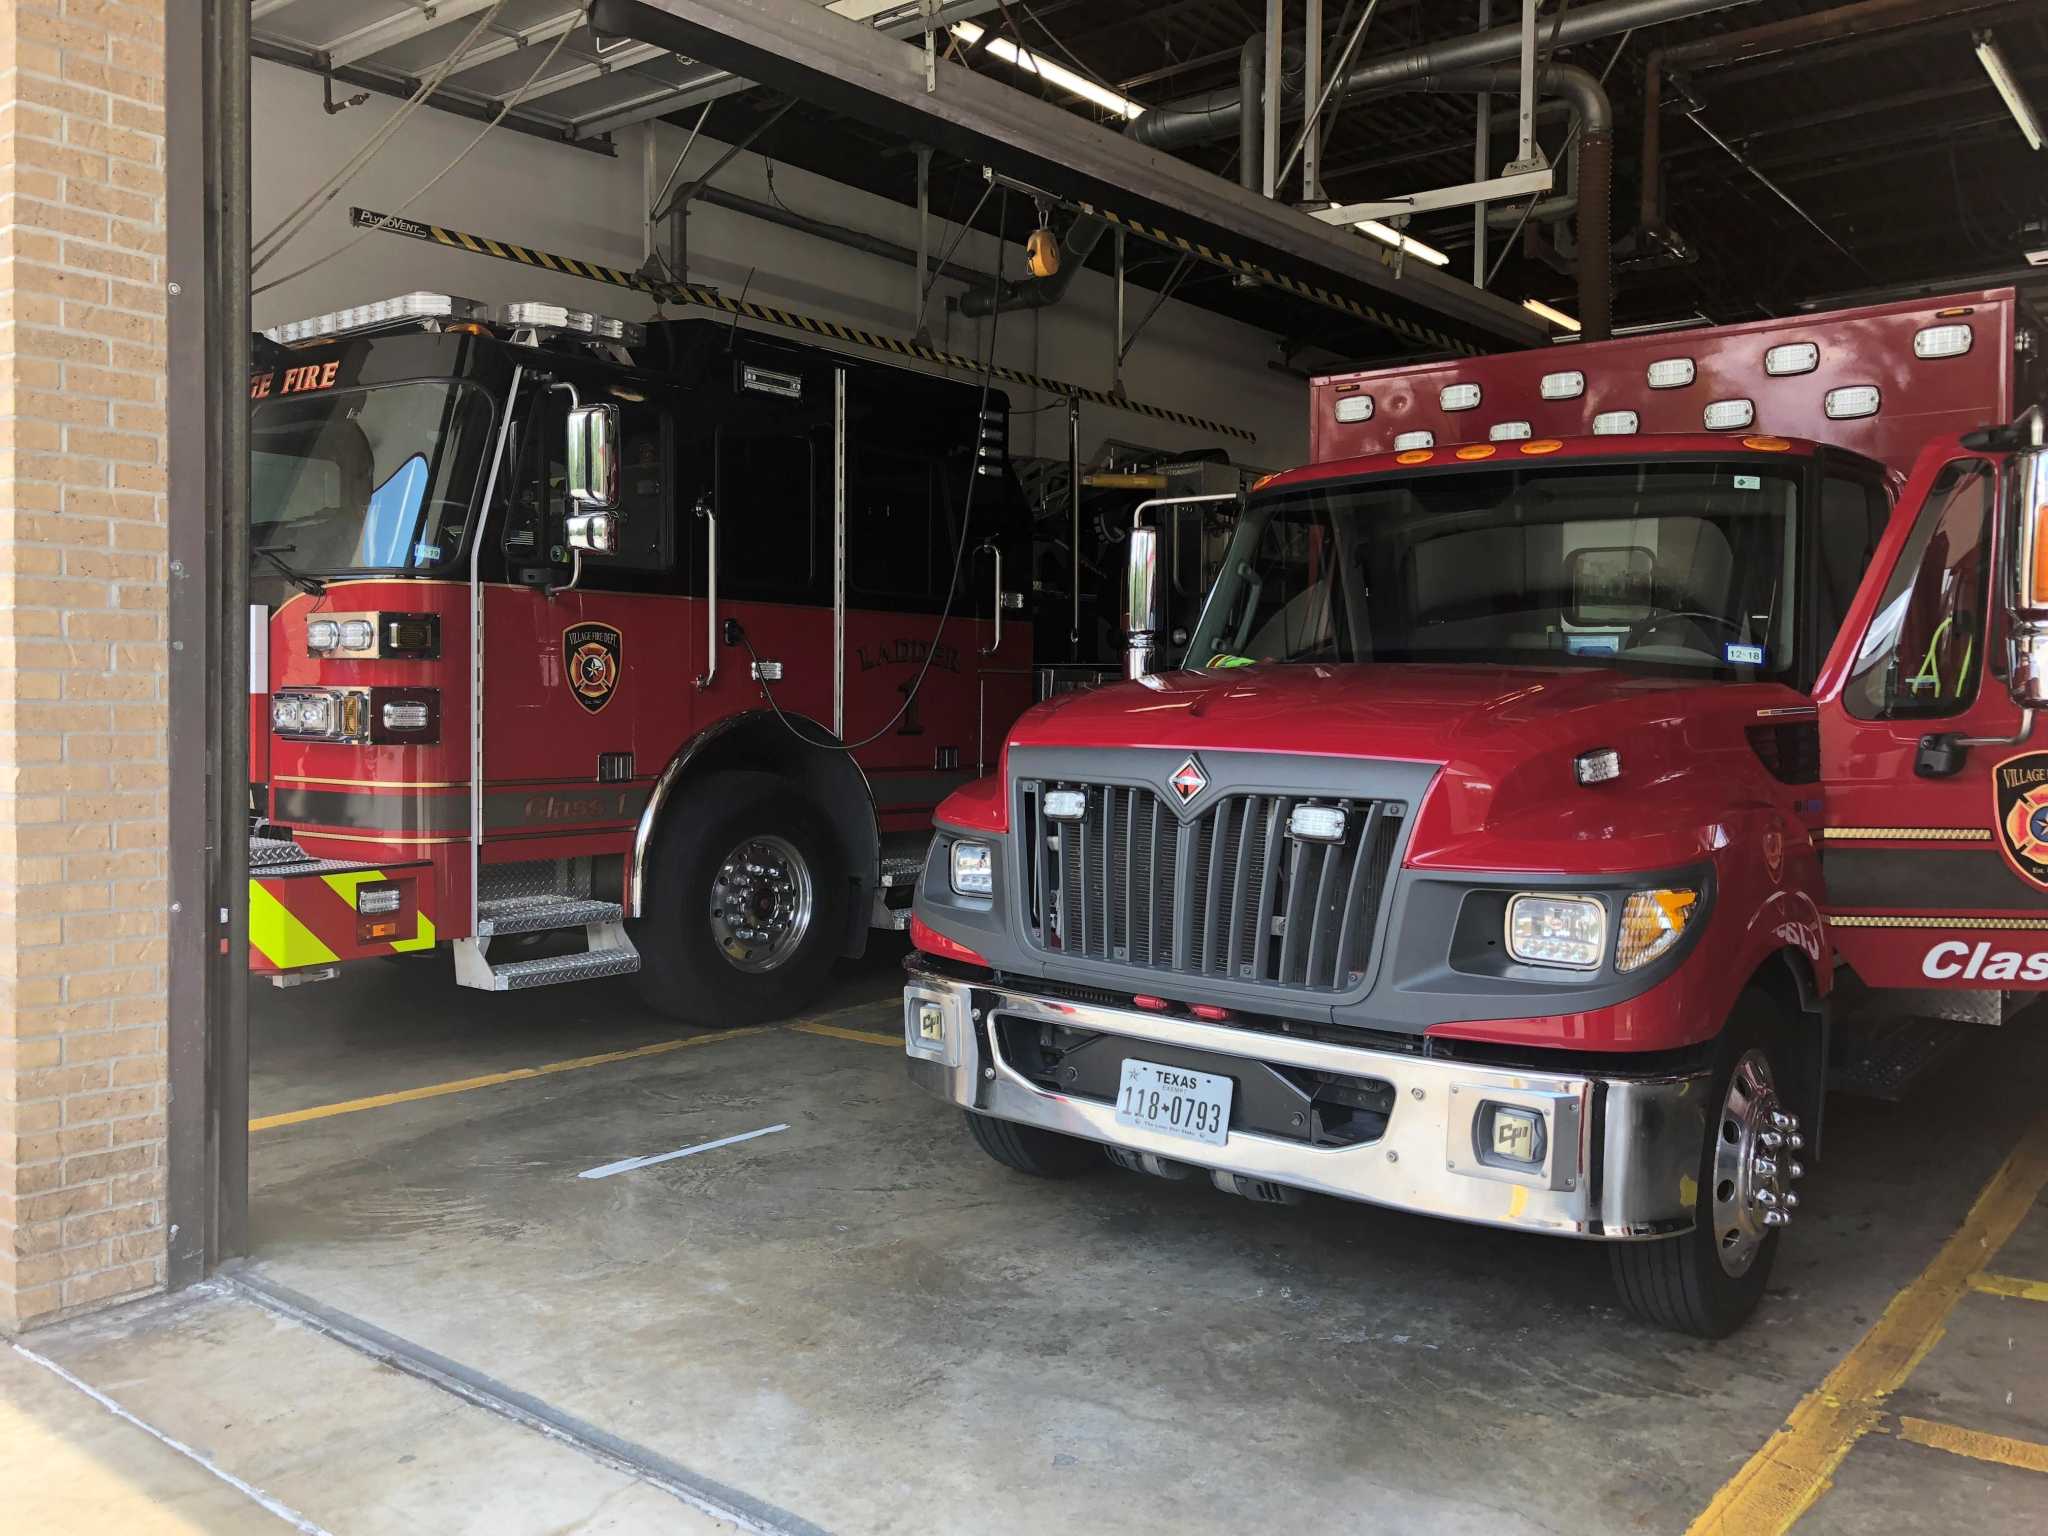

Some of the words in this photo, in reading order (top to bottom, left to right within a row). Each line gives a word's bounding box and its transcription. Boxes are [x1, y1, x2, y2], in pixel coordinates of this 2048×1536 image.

[280, 360, 340, 394] FIRE
[857, 639, 961, 673] LADDER
[897, 674, 925, 736] 1
[2003, 768, 2045, 788] VILLAGE
[525, 796, 606, 818] Class
[616, 792, 627, 816] 1
[1922, 940, 2048, 981] Clas
[1156, 1070, 1197, 1090] TEXAS
